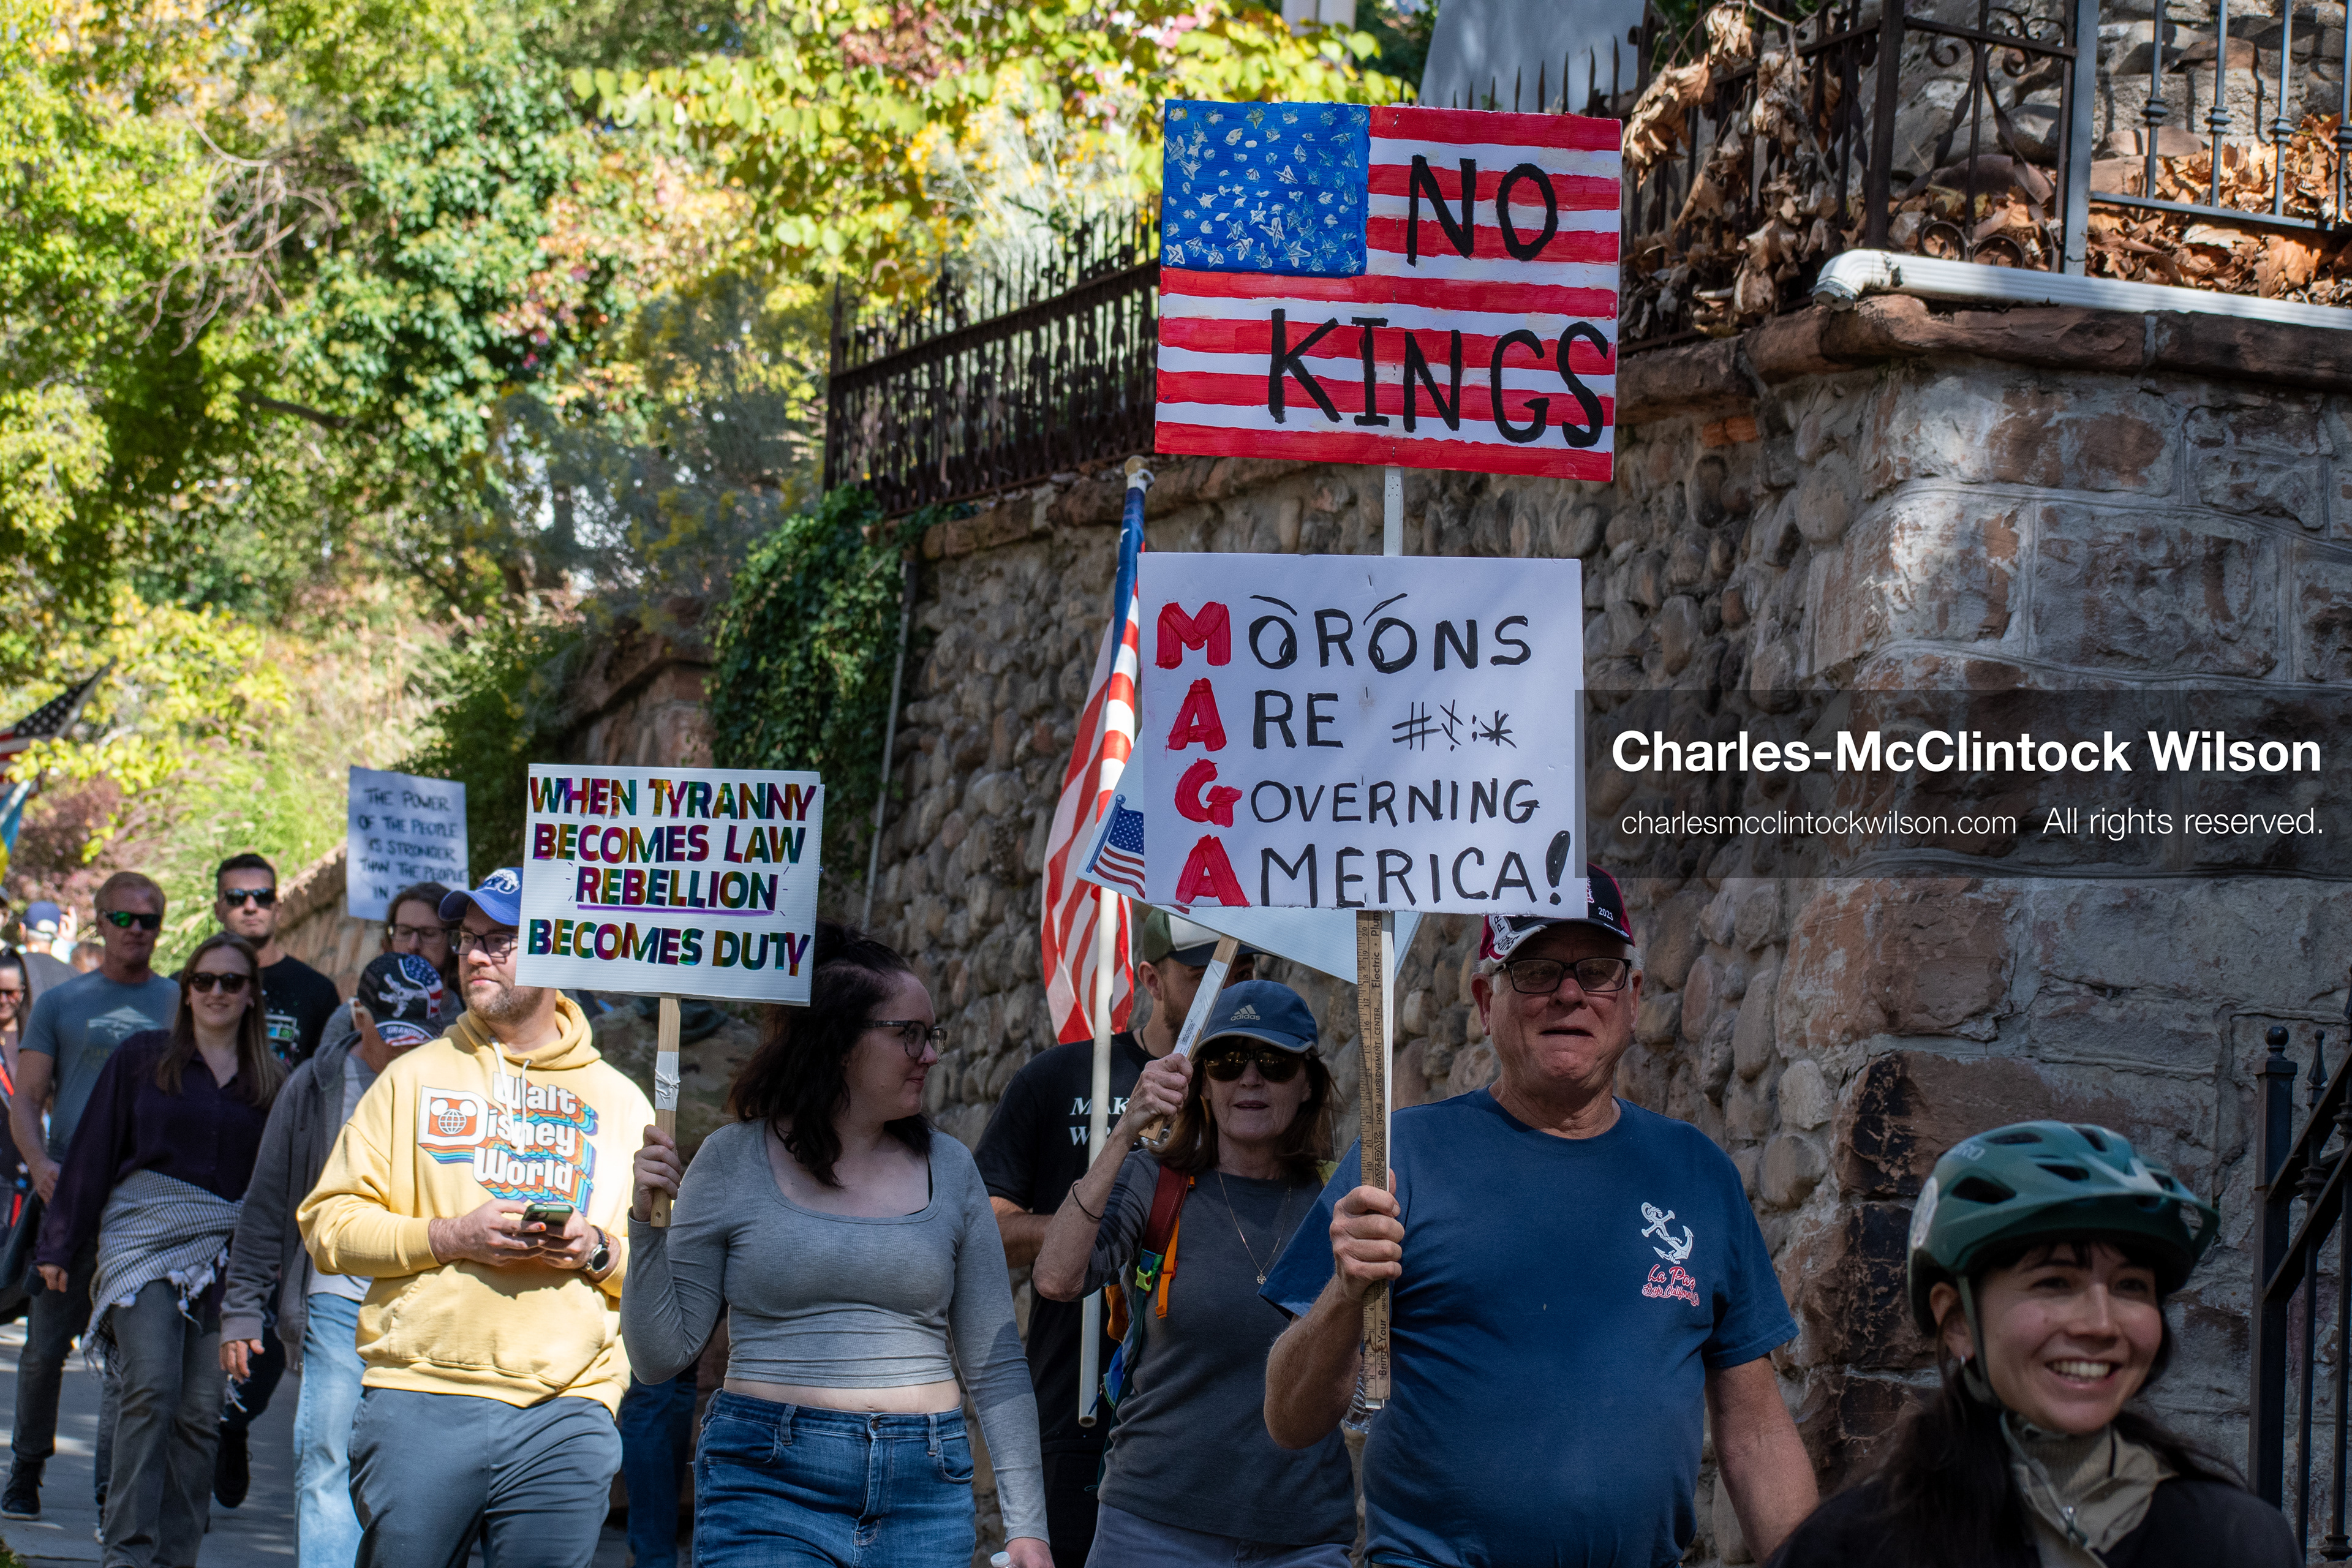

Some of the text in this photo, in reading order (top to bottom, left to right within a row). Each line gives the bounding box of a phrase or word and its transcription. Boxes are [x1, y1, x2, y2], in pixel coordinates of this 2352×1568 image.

[1407, 154, 1559, 267] NO
[1268, 308, 1609, 448] KINGS
[1156, 599, 1532, 674] MORONS
[1166, 678, 1344, 752] ARE
[364, 788, 451, 812] THE POWER
[529, 777, 817, 821] WHEN TYRANNY
[1174, 758, 1540, 828] GOVERNING
[358, 815, 458, 838] OF THE PEOPLE
[532, 823, 807, 864] BECOMES LAW
[360, 858, 467, 883] THAN THE PEOPLE
[369, 838, 458, 863] IS STRONGER
[1175, 830, 1571, 908] AMERICA!
[374, 886, 388, 899] IN
[575, 866, 779, 911] REBELLION
[1597, 907, 1614, 921] 2023
[527, 919, 811, 977] BECOMES DUTY
[1372, 952, 1381, 988] Electric
[1230, 1013, 1261, 1022] adidas
[492, 1072, 578, 1115] Walt
[473, 1145, 575, 1193] World
[1648, 1264, 1696, 1291] La Paz
[1378, 1319, 1389, 1376] Bring Your
